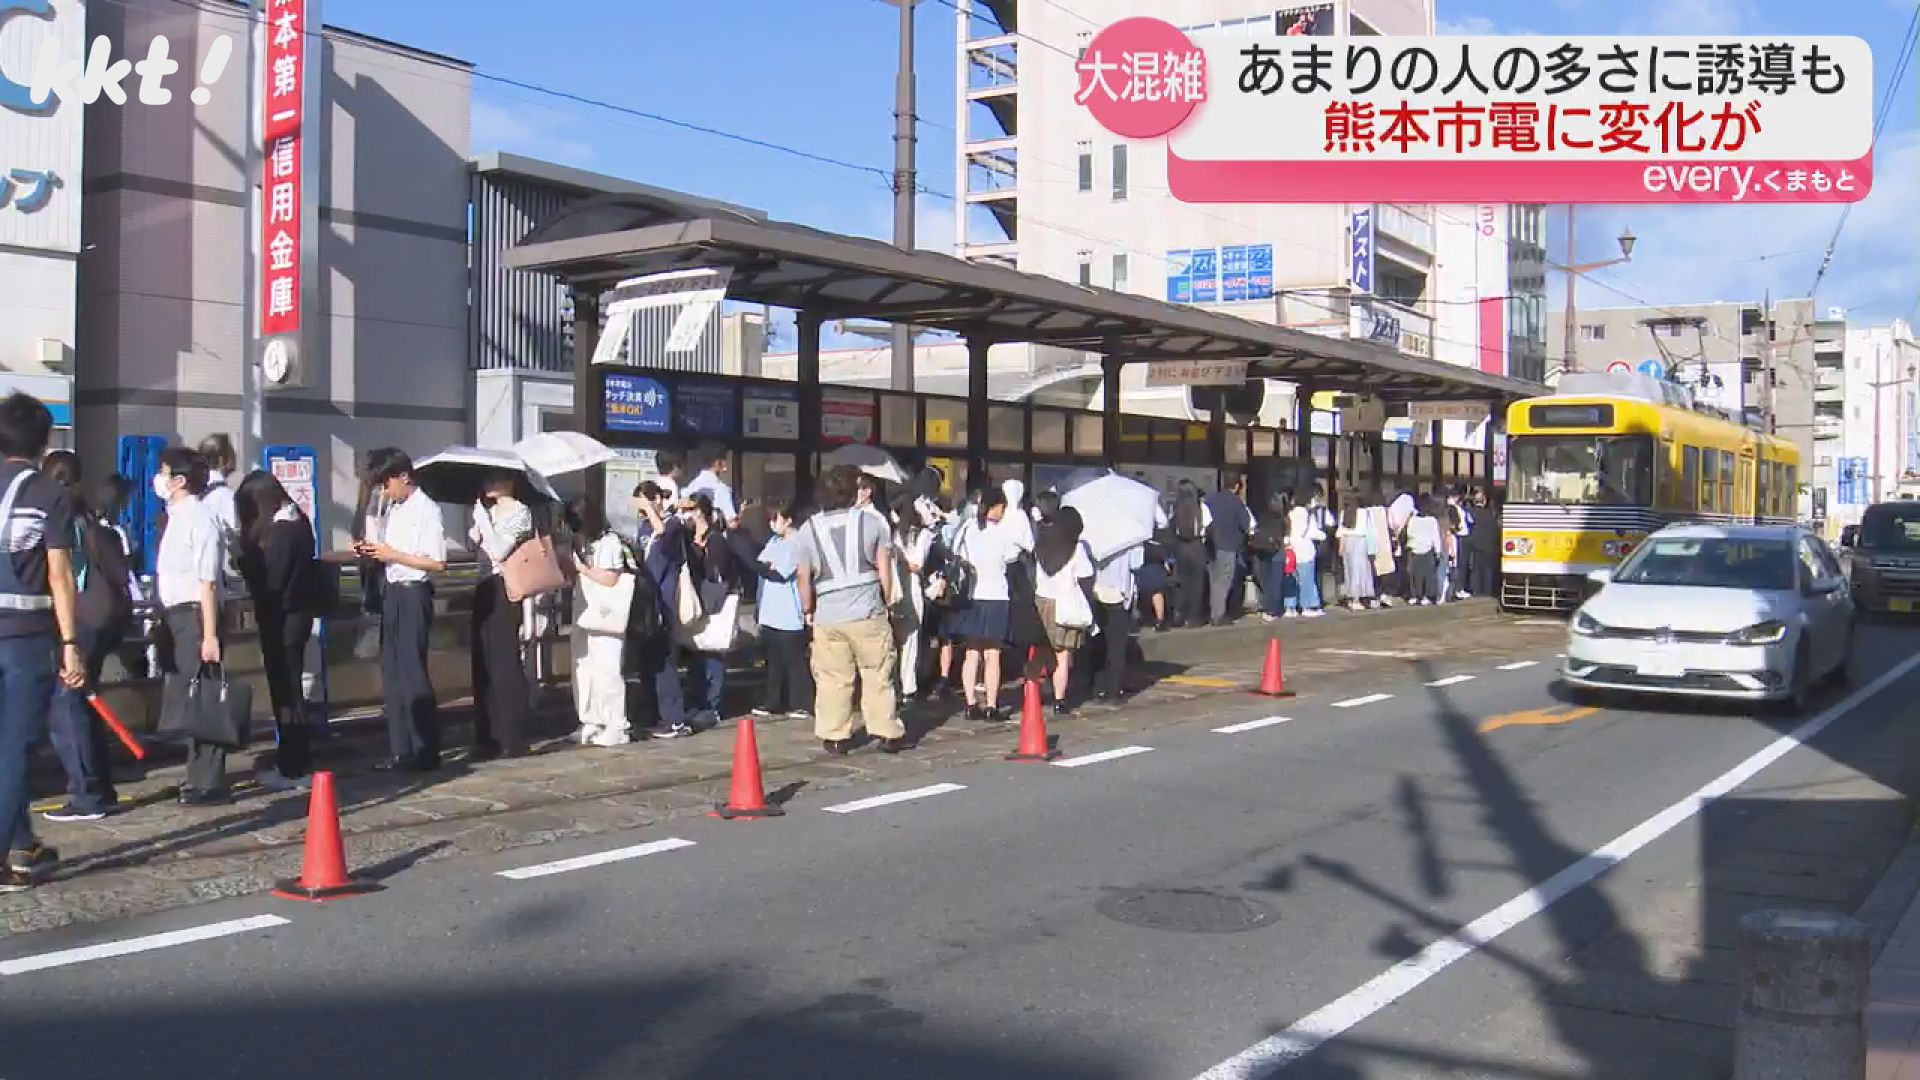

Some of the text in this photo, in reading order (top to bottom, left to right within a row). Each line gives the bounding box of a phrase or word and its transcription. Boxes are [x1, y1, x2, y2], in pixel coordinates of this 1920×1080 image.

[269, 0, 298, 317] 本第一信用金庫
[1353, 214, 1369, 284] アスト
